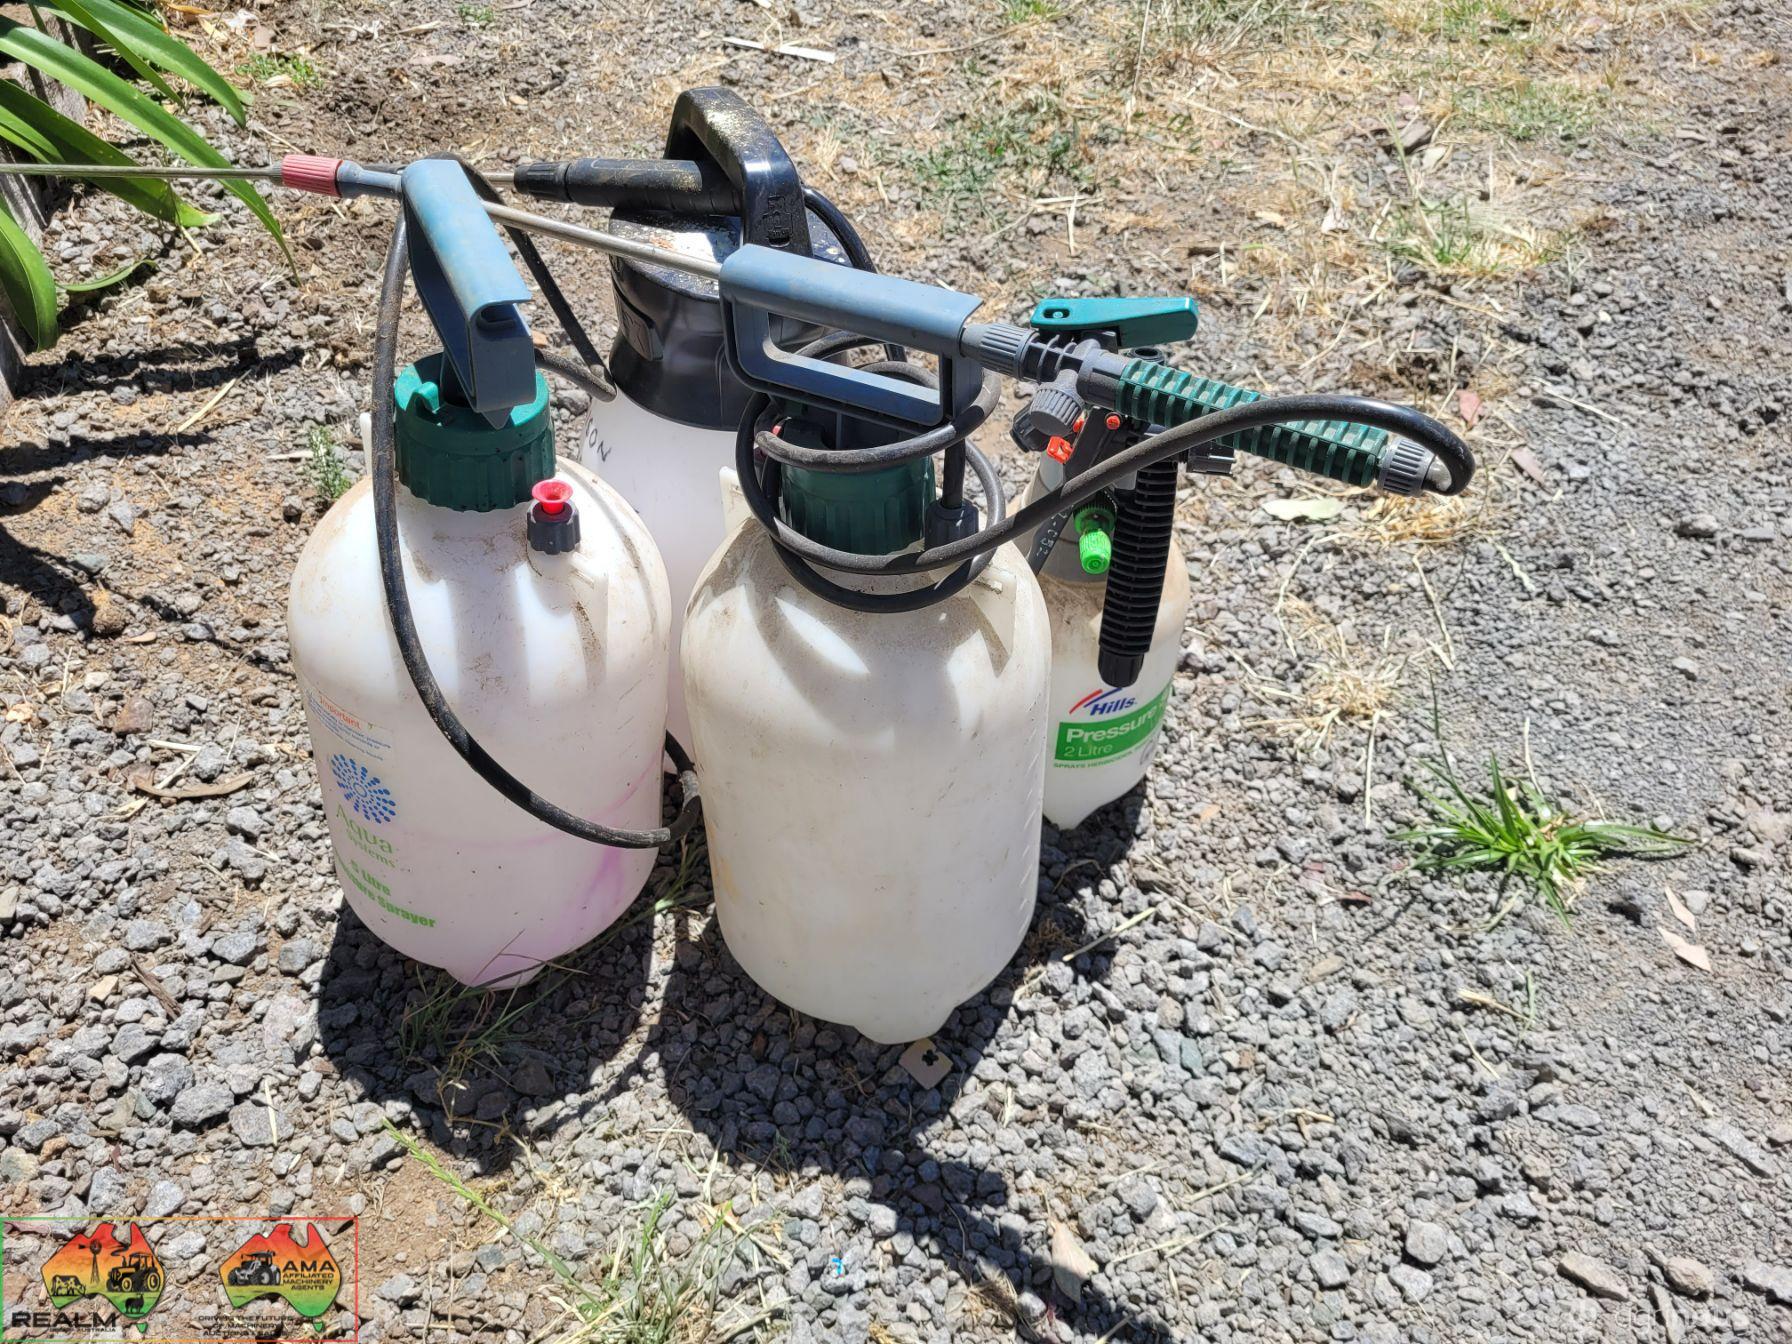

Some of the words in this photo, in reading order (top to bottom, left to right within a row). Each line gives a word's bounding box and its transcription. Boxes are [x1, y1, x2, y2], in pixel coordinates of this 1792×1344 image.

[1090, 697, 1136, 716] Hills
[1064, 746, 1074, 757] 2
[1078, 744, 1113, 757] Litre
[336, 804, 393, 854] Aqua
[377, 895, 437, 928] Sprayer
